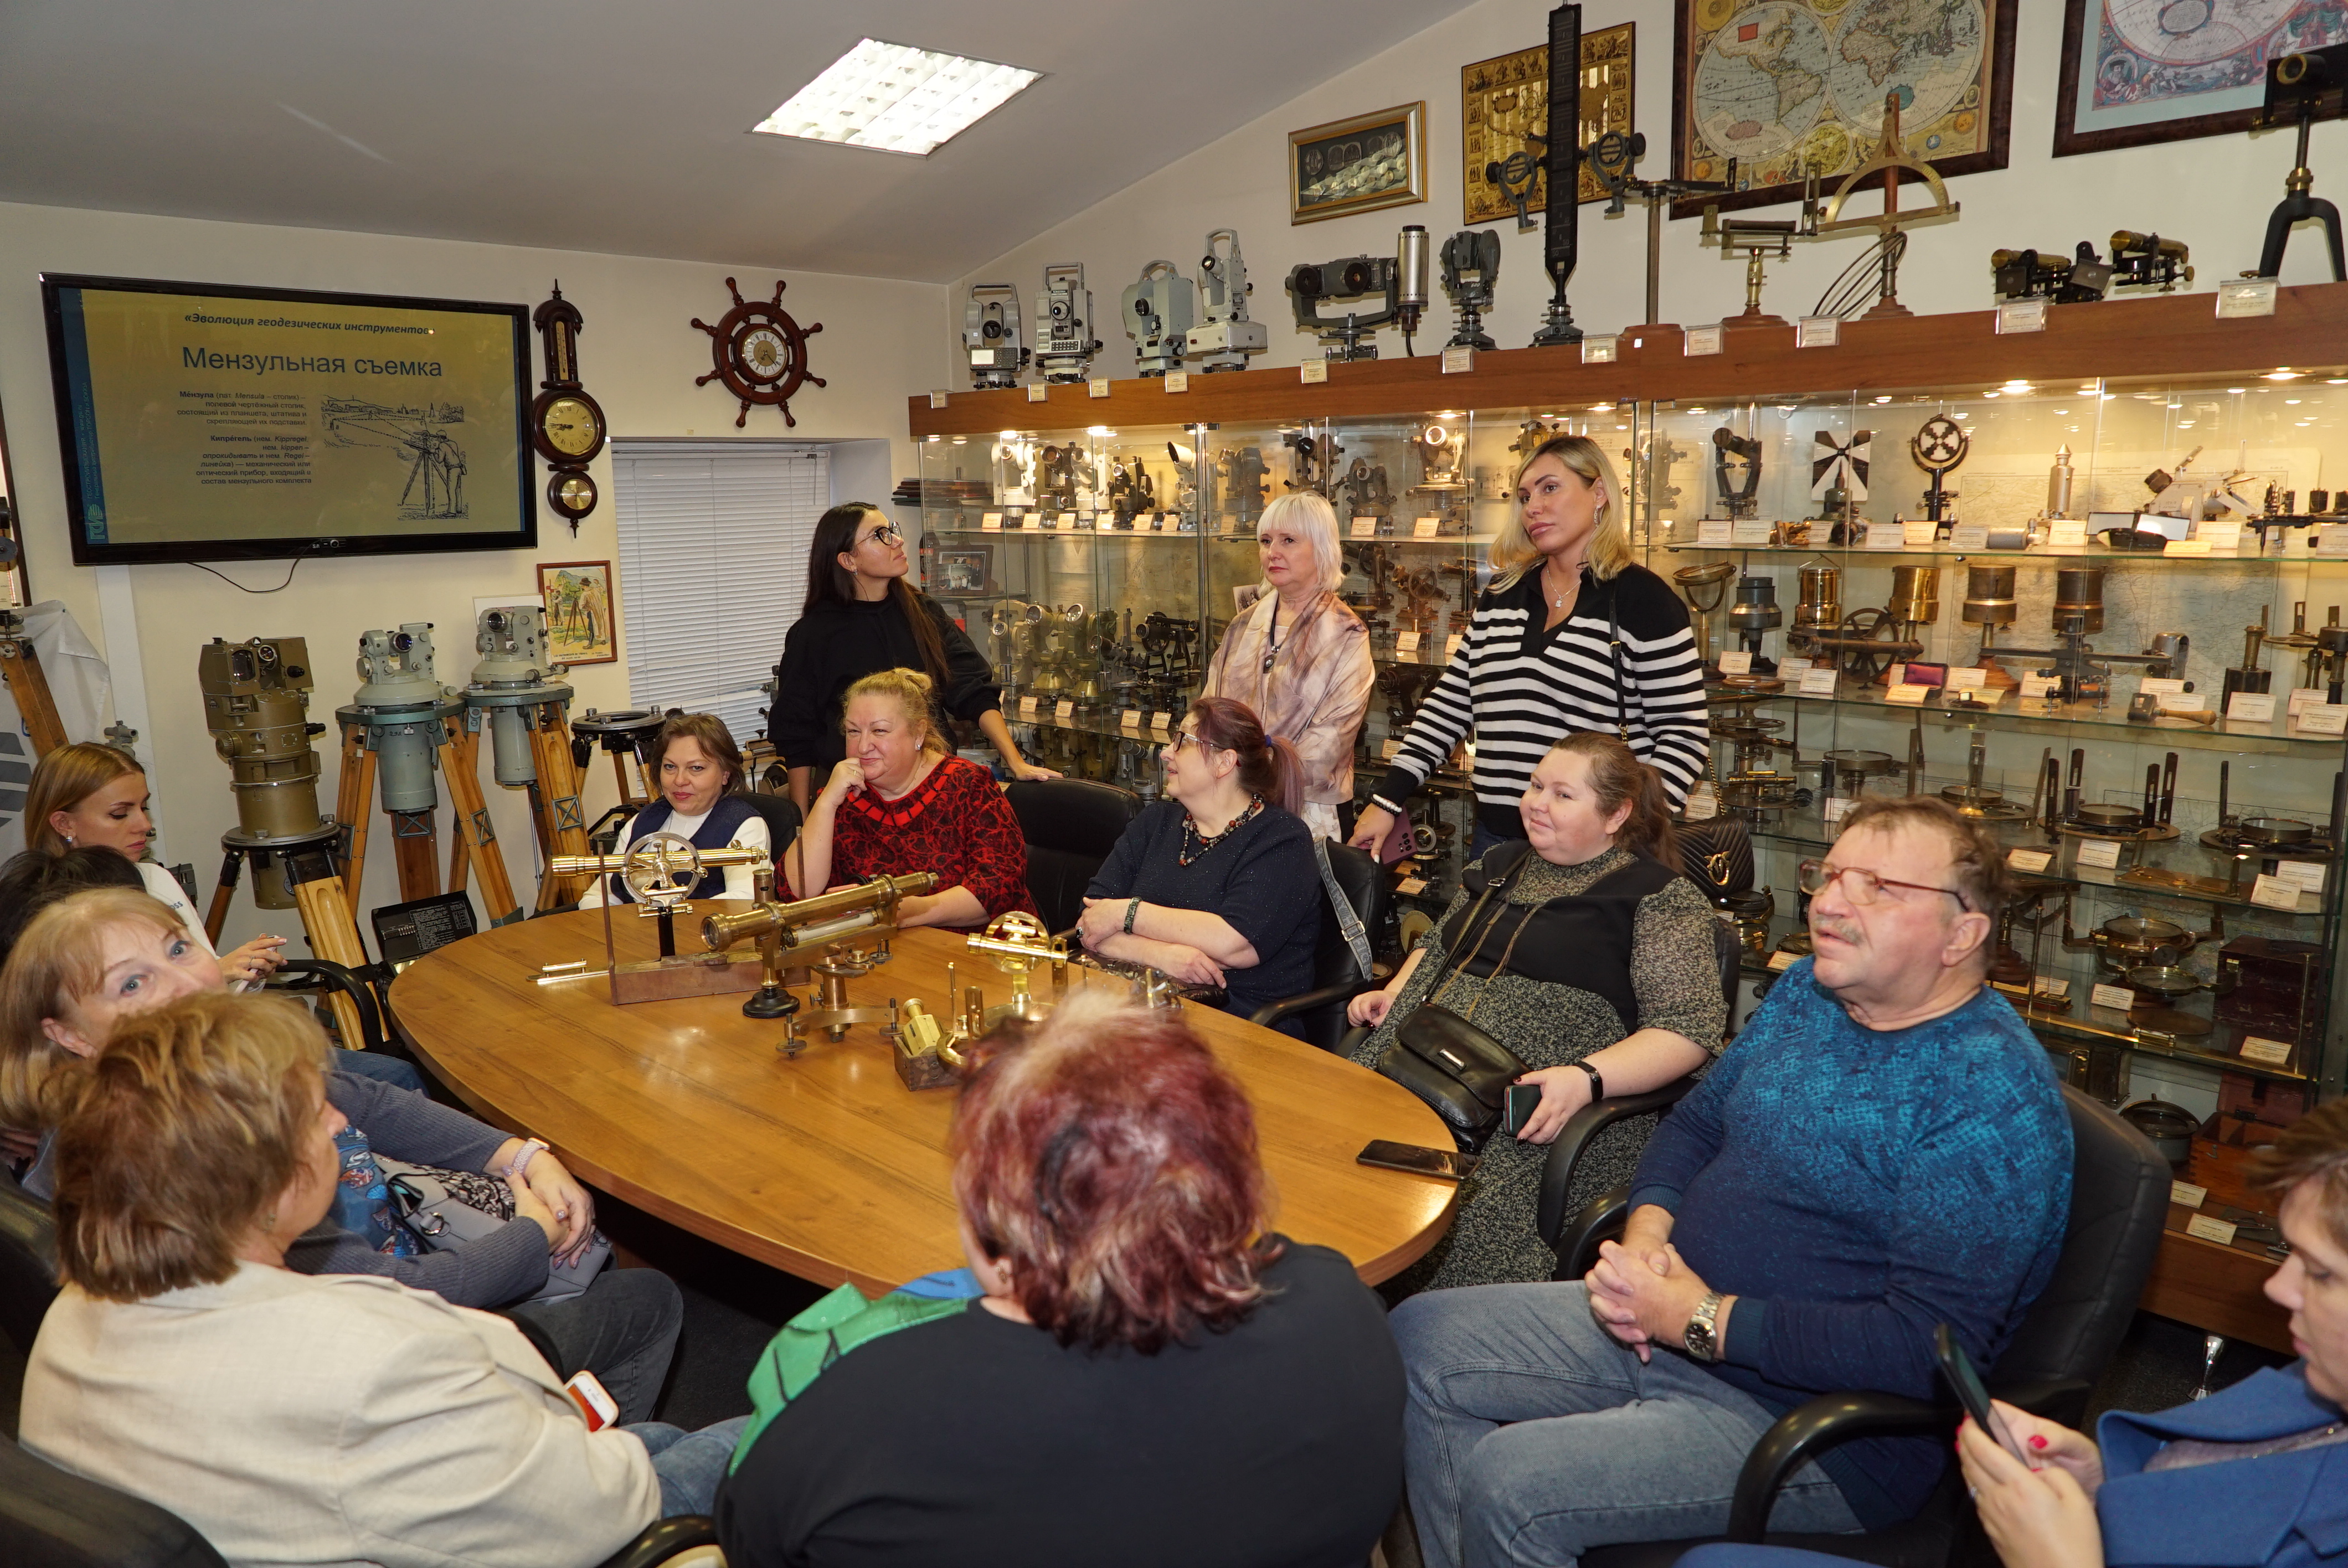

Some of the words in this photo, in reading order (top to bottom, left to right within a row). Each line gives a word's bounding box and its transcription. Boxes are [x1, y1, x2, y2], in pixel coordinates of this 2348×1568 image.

[184, 313, 254, 326] «Эволюция
[258, 318, 341, 331] геодезических
[183, 347, 346, 376] Мензульная
[354, 358, 442, 377] съемка
